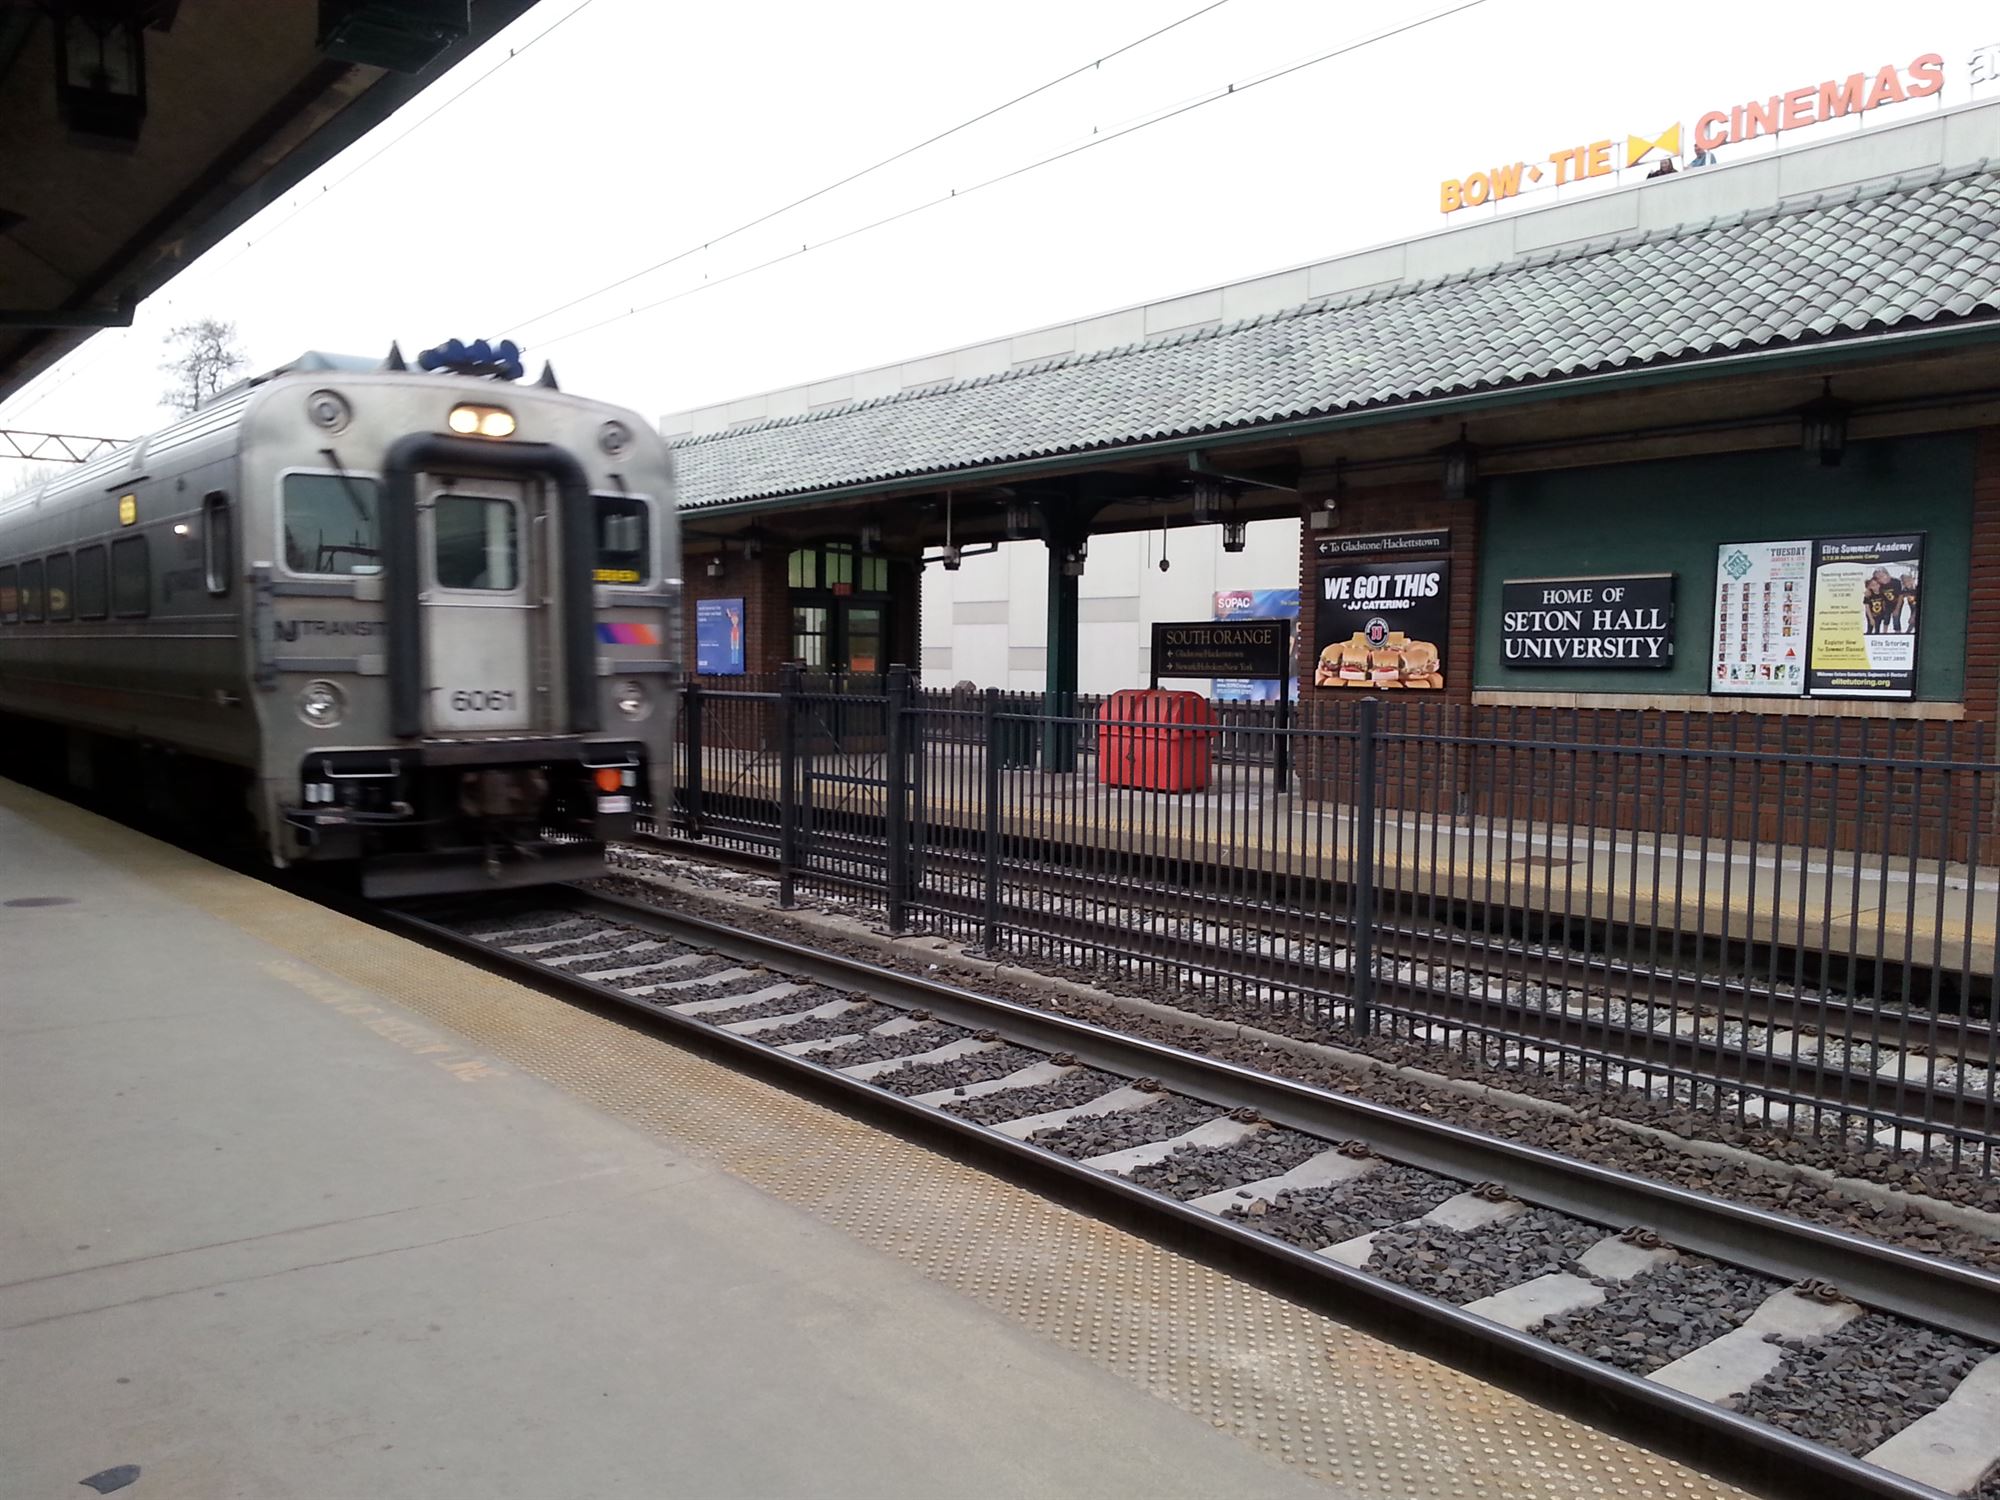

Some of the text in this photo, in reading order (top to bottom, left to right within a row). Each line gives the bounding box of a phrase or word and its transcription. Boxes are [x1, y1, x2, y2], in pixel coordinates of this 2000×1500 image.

[1440, 53, 1945, 213] BOW TIE CINEMAS
[1329, 537, 1440, 553] To Gladstone/Hackettstown
[1770, 547, 1807, 557] TUESDAY
[1822, 542, 1914, 555] Elite Summer Academy
[1324, 573, 1440, 600] WE GOT THIS
[1218, 597, 1250, 608] SOPAC
[1542, 587, 1625, 605] HOME OF
[1348, 600, 1410, 610] JJ CATERING
[1504, 608, 1667, 632] SETON HALL
[1166, 629, 1272, 645] SOUTH ORANGE
[1504, 636, 1665, 659] UNIVERSITY
[1831, 678, 1891, 687] elitetutoring.org
[449, 690, 518, 712] 6061
